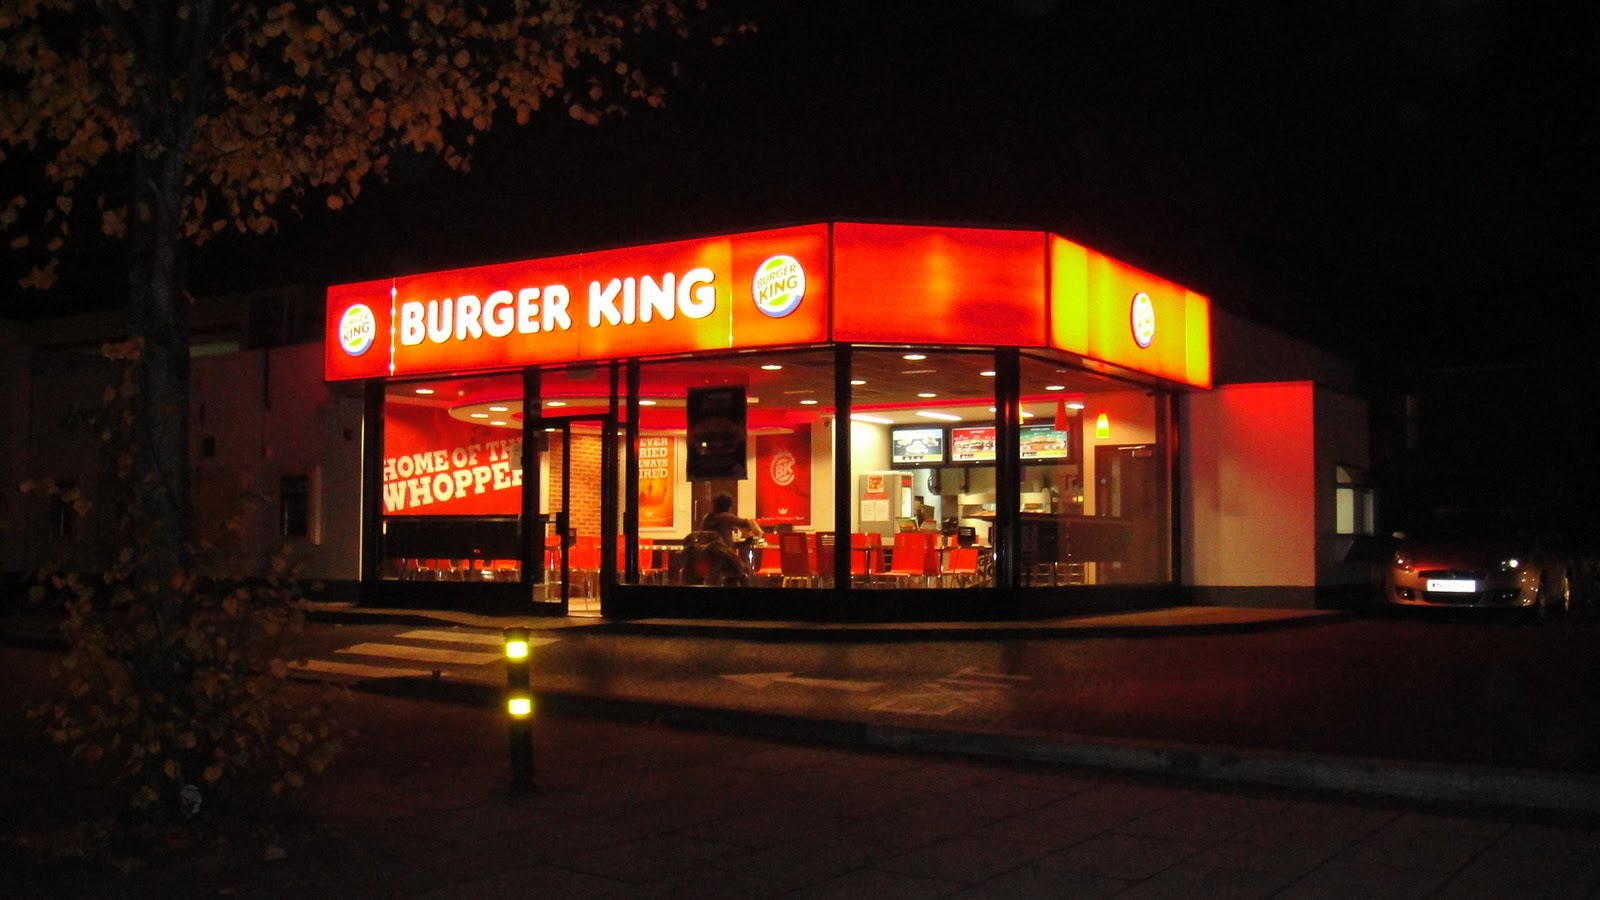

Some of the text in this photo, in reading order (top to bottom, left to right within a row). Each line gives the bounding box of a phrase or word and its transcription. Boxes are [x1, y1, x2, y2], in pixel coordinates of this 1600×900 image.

[757, 264, 796, 289] BURGER
[759, 275, 798, 304] KING
[401, 268, 716, 346] BURGER KING
[343, 321, 370, 344] KING
[639, 447, 668, 458] RIED
[640, 437, 668, 447] EVER
[384, 437, 522, 481] HOME OF TH
[639, 458, 668, 468] LWAYS
[639, 468, 669, 479] IRED
